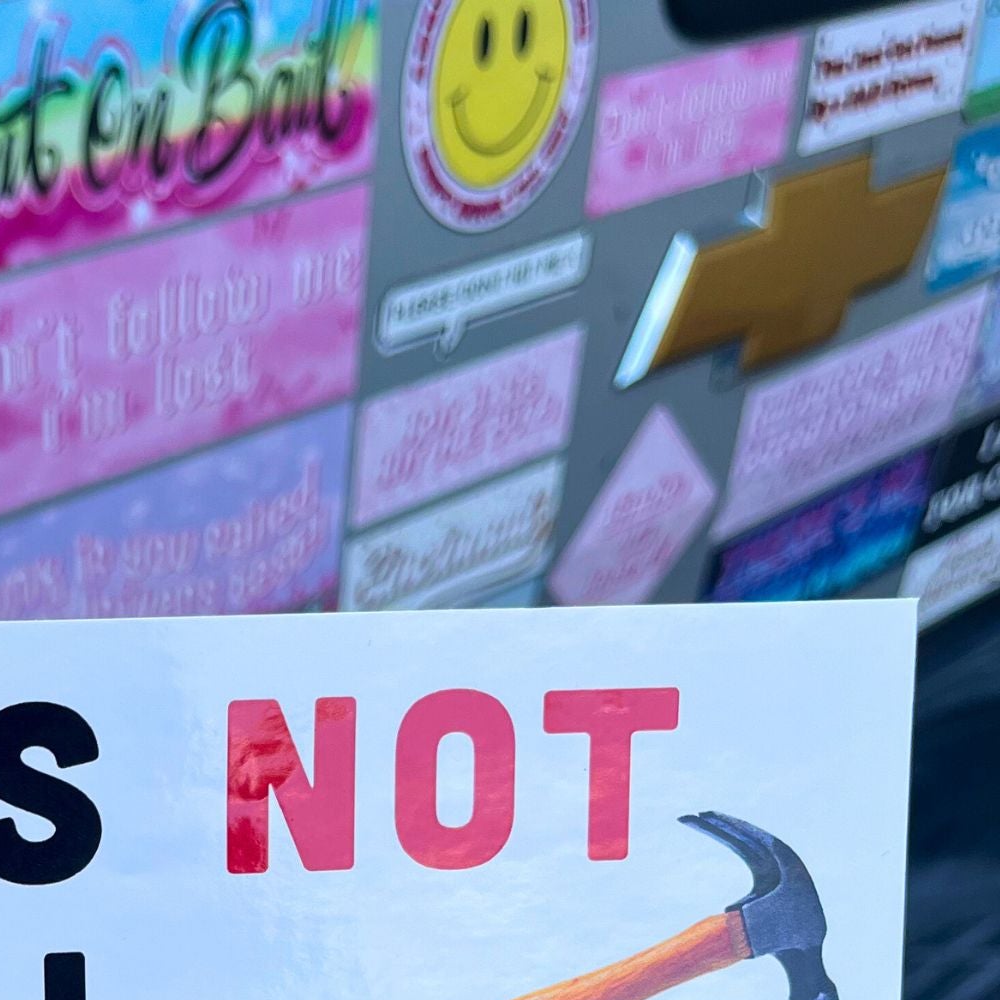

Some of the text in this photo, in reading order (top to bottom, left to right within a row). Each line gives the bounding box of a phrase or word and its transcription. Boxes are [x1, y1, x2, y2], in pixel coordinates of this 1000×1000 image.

[82, 62, 174, 190] On
[178, 0, 352, 183] Bail
[106, 262, 272, 362] follow
[292, 243, 364, 306] me
[226, 687, 680, 874] NOT
